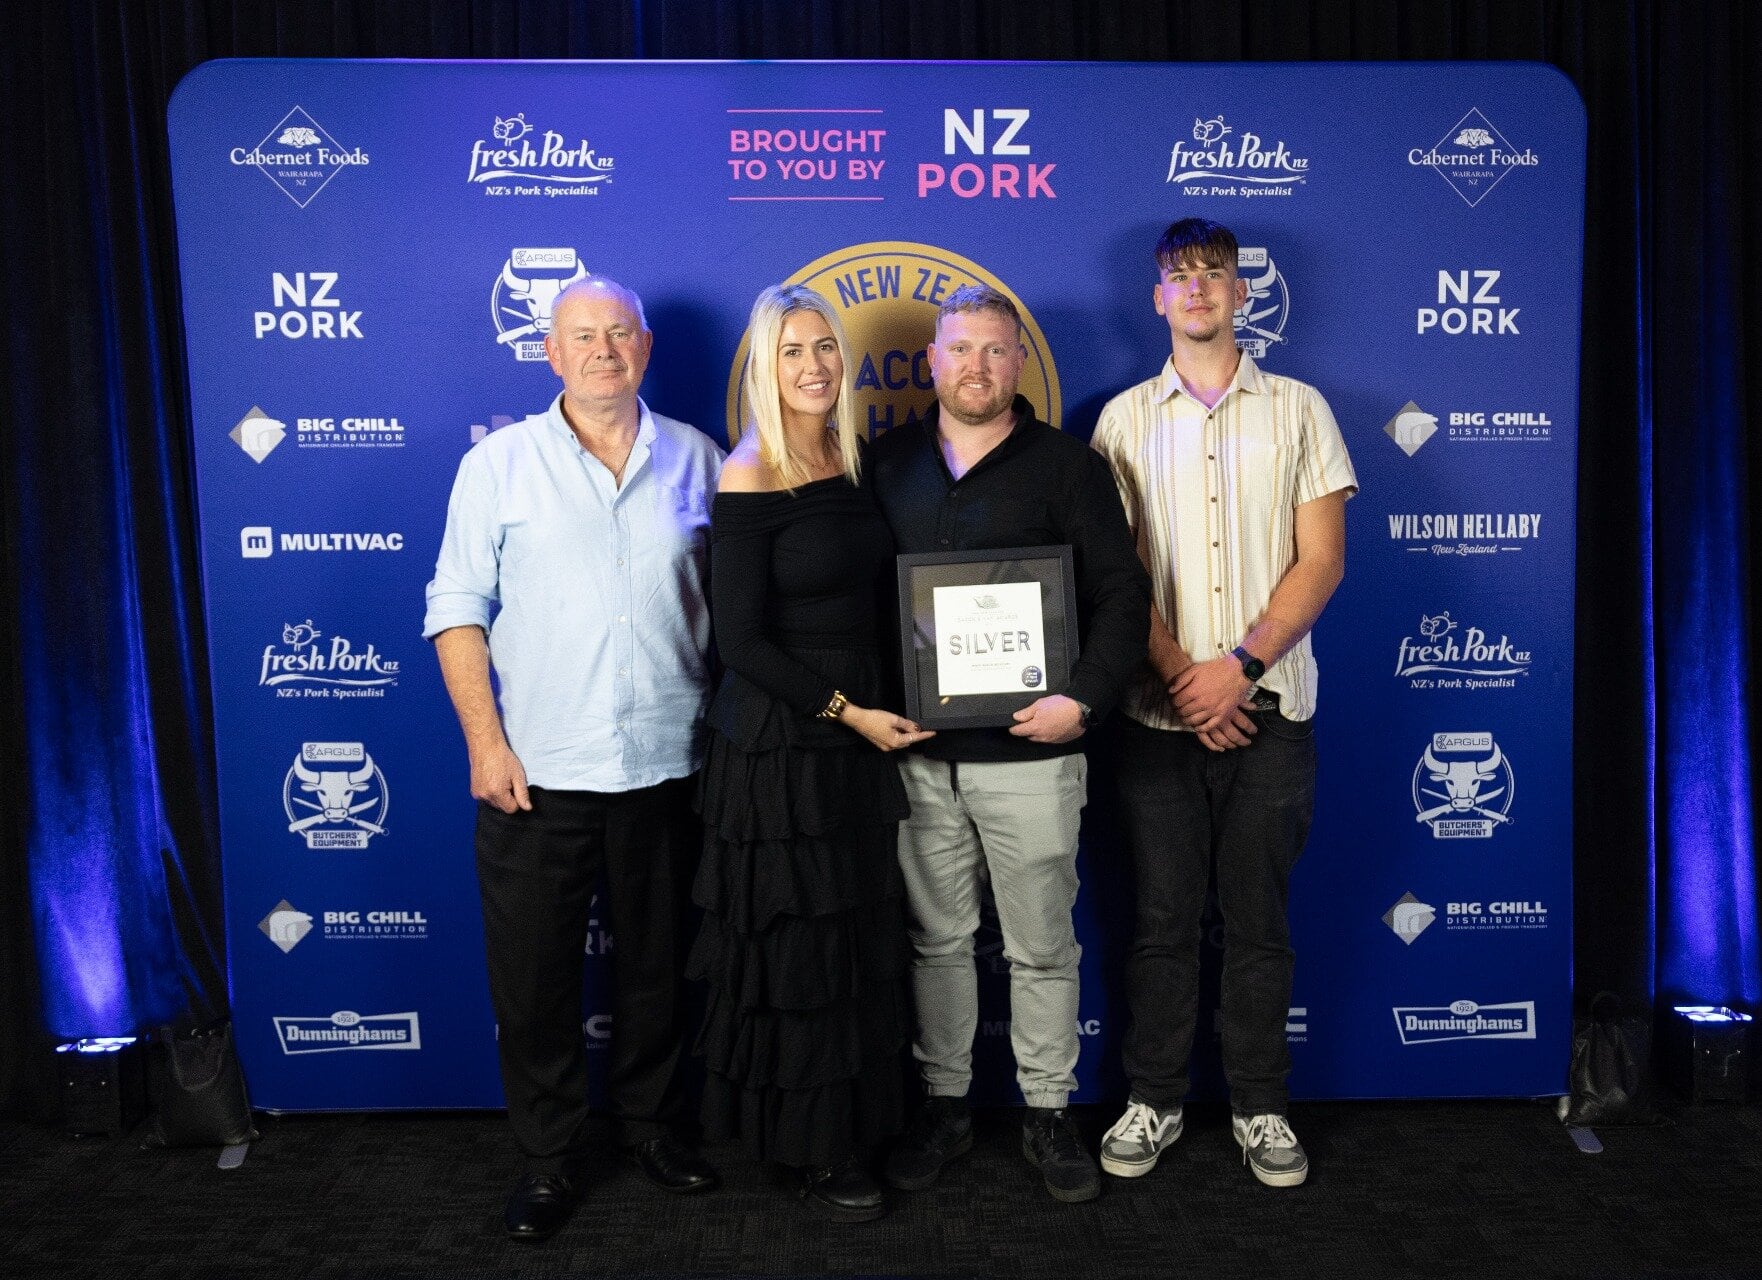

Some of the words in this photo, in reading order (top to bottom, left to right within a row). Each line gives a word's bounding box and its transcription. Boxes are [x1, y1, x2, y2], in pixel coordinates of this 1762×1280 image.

[944, 109, 1030, 155] NZ
[730, 130, 886, 152] BROUGHT
[231, 147, 313, 167] Cabernet
[318, 147, 369, 167] Foods
[468, 139, 540, 183] fresh
[540, 130, 596, 169] Pork
[597, 157, 614, 168] nz
[1166, 140, 1236, 183] fresh
[1236, 132, 1293, 169] Pork
[1293, 158, 1309, 169] nz
[1408, 149, 1484, 167] Cabernet
[1491, 149, 1538, 166] Foods
[278, 170, 323, 178] WAIRARAPA
[728, 160, 766, 180] TO
[777, 160, 836, 180] YOU
[848, 160, 886, 180] BY
[1453, 170, 1494, 178] WAIRARAPA
[918, 163, 1057, 198] PORK
[1468, 178, 1478, 186] NZ
[486, 186, 511, 196] NZ's
[515, 186, 540, 196] Pork
[544, 185, 598, 198] Specialist
[1184, 187, 1208, 196] NZ's
[1212, 187, 1236, 196] Pork
[1240, 186, 1292, 198] Specialist
[525, 253, 573, 262] ARGUS
[1238, 253, 1265, 262] GUS
[272, 273, 339, 307] NZ
[835, 265, 901, 309] NEW
[912, 267, 962, 307] ZE
[1438, 270, 1500, 304] NZ
[255, 311, 363, 339] PORK
[1417, 308, 1520, 335] PORK
[521, 343, 545, 351] BUTC
[521, 351, 547, 359] EQUIP
[298, 419, 335, 431] BIG
[342, 418, 404, 431] CHILL
[1450, 413, 1485, 425] BIG
[1493, 413, 1551, 425] CHILL
[298, 433, 402, 441] DISTRIBUTION
[1450, 428, 1549, 436] DISTRIBUTION
[1389, 515, 1458, 539] WILSON
[1464, 514, 1541, 539] HELLABY
[281, 533, 403, 551] MULTIVAC
[1432, 544, 1456, 555] New
[1456, 544, 1498, 556] Zealand
[949, 631, 1031, 655] SILVER
[1395, 635, 1460, 676] fresh
[1462, 627, 1515, 663] Pork
[1516, 651, 1531, 661] nz
[259, 643, 326, 685] fresh
[328, 636, 383, 673] Pork
[384, 661, 399, 671] nz
[1411, 680, 1435, 689] NZ's
[1438, 679, 1462, 688] Pork
[1465, 679, 1515, 690] Specialist
[277, 688, 301, 697] NZ's
[304, 688, 330, 697] Pork
[333, 688, 385, 699] Specialist
[1445, 737, 1490, 746] ARGUS
[315, 747, 361, 756] ARGUS
[1439, 821, 1485, 829] BUTCHERS'
[313, 831, 361, 839] BUTCHERS'
[1439, 829, 1487, 837] EQUIPMENT
[313, 839, 362, 847] EQUIPMENT
[1447, 903, 1481, 914] BIG
[1489, 902, 1547, 914] CHILL
[324, 912, 360, 923] BIG
[367, 912, 427, 923] CHILL
[1447, 916, 1545, 924] DISTRIBUTION
[324, 925, 426, 933] DISTRIBUTION
[1456, 1005, 1474, 1013] 1921
[1405, 1014, 1524, 1034] Dunninghams
[286, 1025, 407, 1045] Dunninghams
